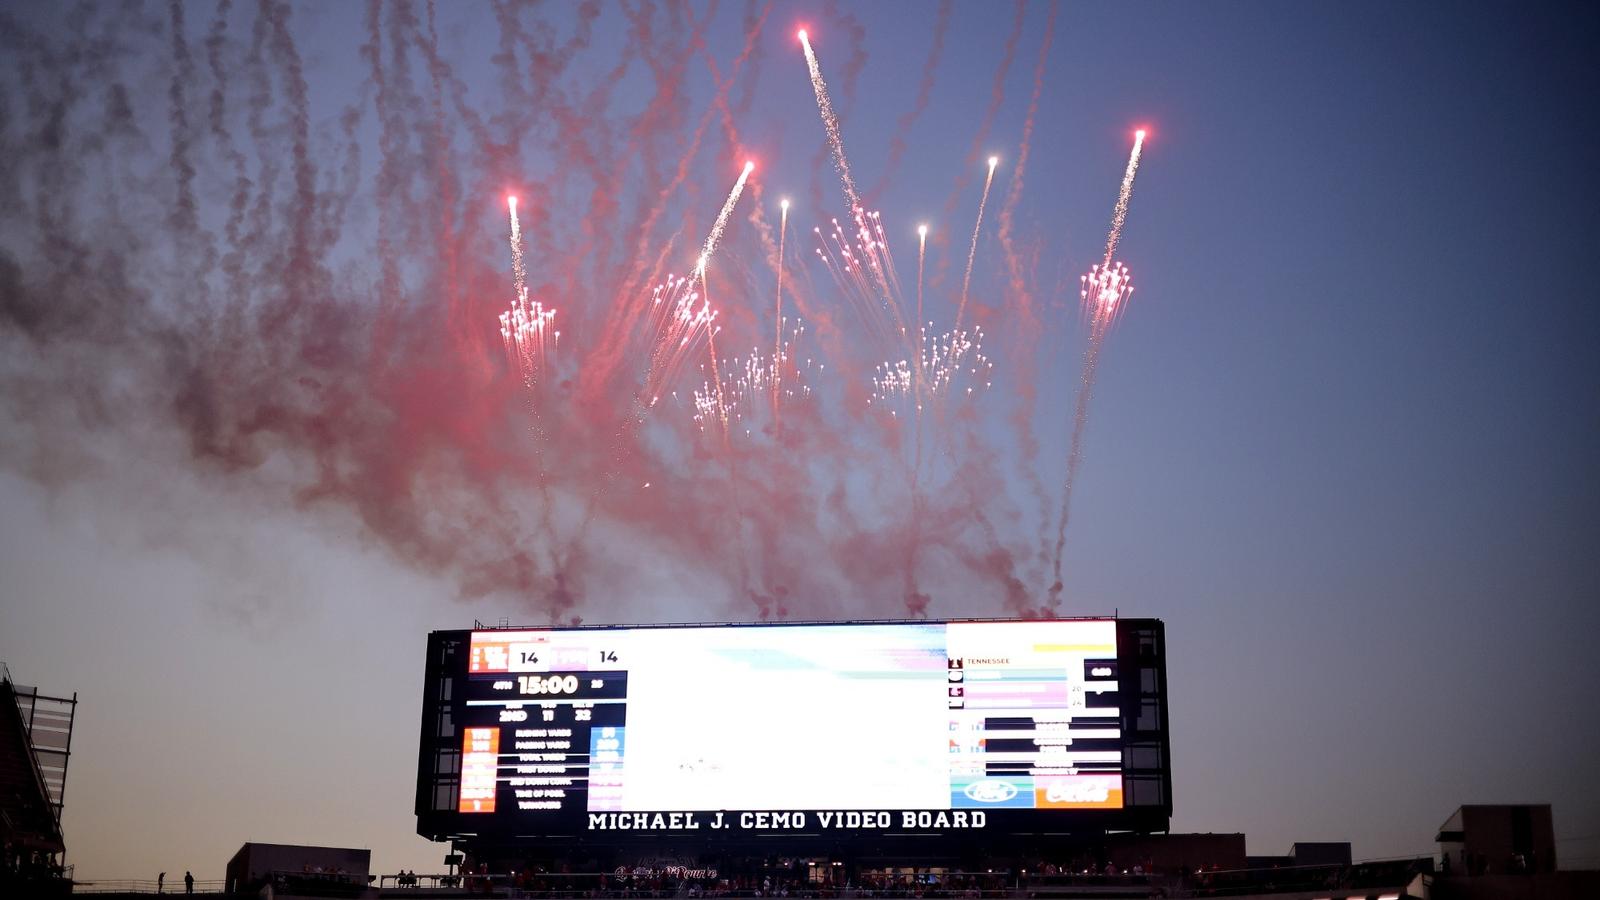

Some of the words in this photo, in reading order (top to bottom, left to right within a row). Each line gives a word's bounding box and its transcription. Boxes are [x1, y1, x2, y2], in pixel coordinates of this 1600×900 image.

[521, 652, 539, 664] 14
[600, 651, 618, 663] 14
[518, 675, 579, 695] 15:00
[588, 813, 699, 829] MICHAEL
[710, 812, 730, 829] J.
[740, 812, 806, 829] CEMO
[817, 811, 891, 828] VIDEO
[901, 811, 986, 828] BOARD
